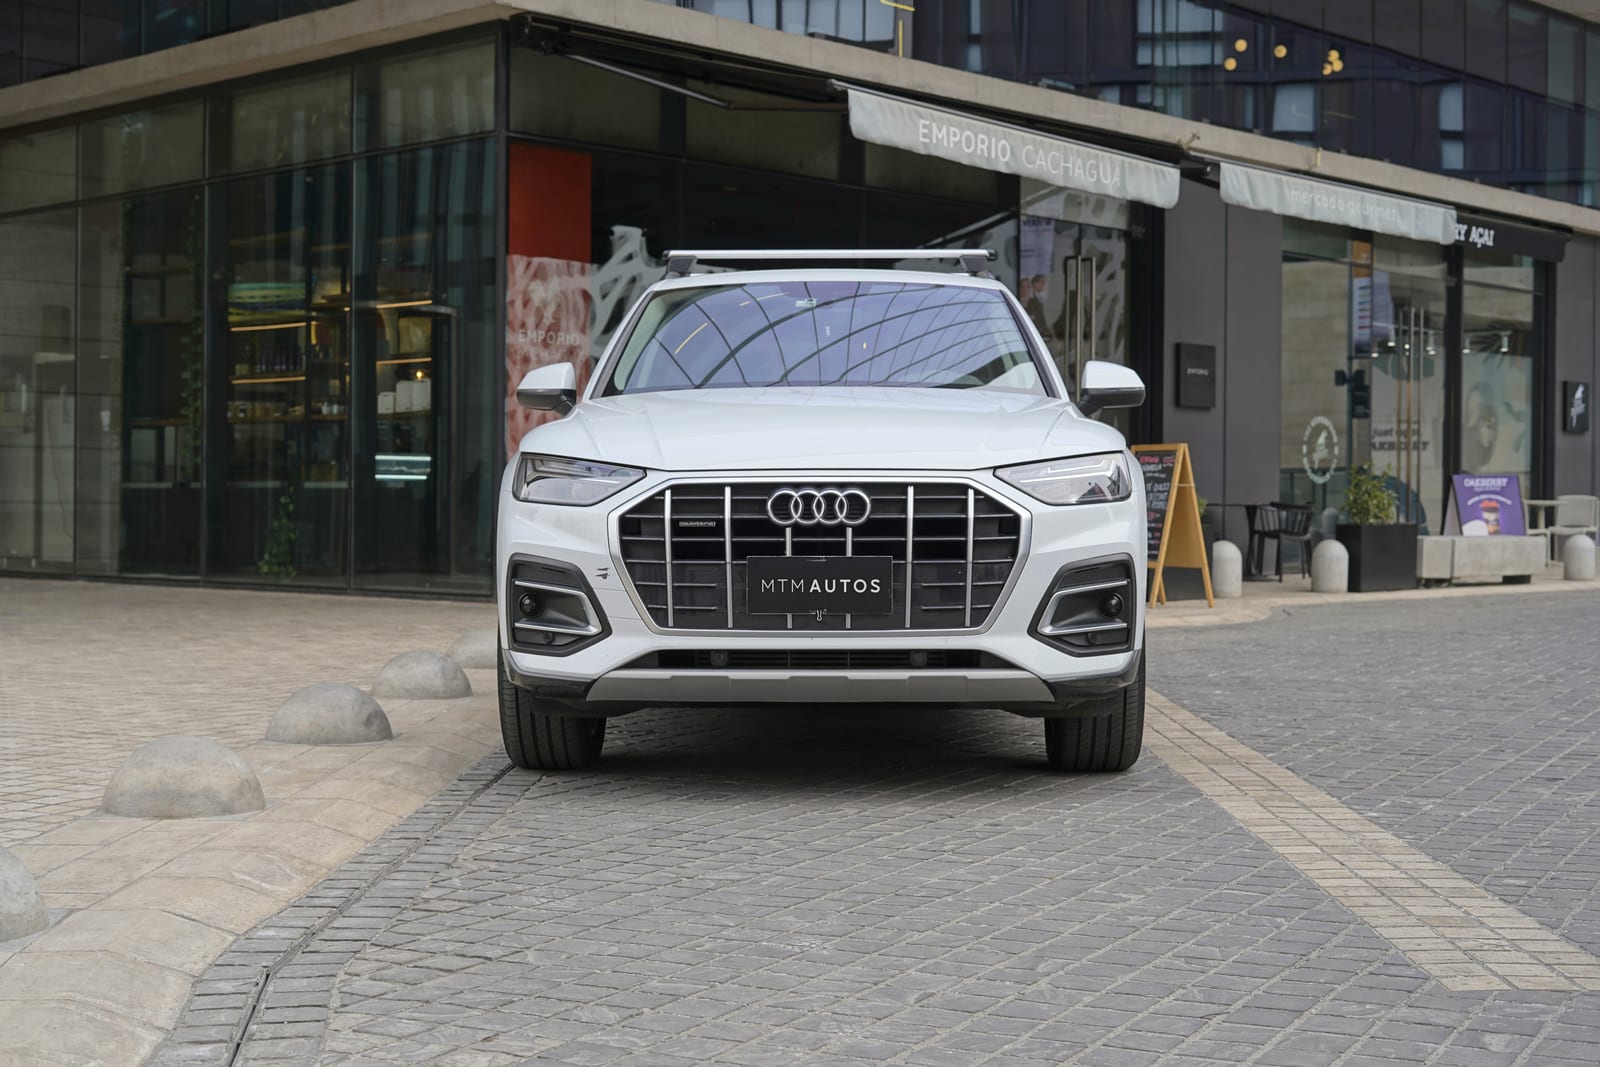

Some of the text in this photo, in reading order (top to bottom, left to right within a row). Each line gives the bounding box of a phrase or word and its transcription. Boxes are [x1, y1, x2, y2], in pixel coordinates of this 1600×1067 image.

[918, 120, 1122, 186] EMPORIO CACHAGUA
[1290, 190, 1345, 211] mercado
[519, 330, 580, 346] EMPORIO
